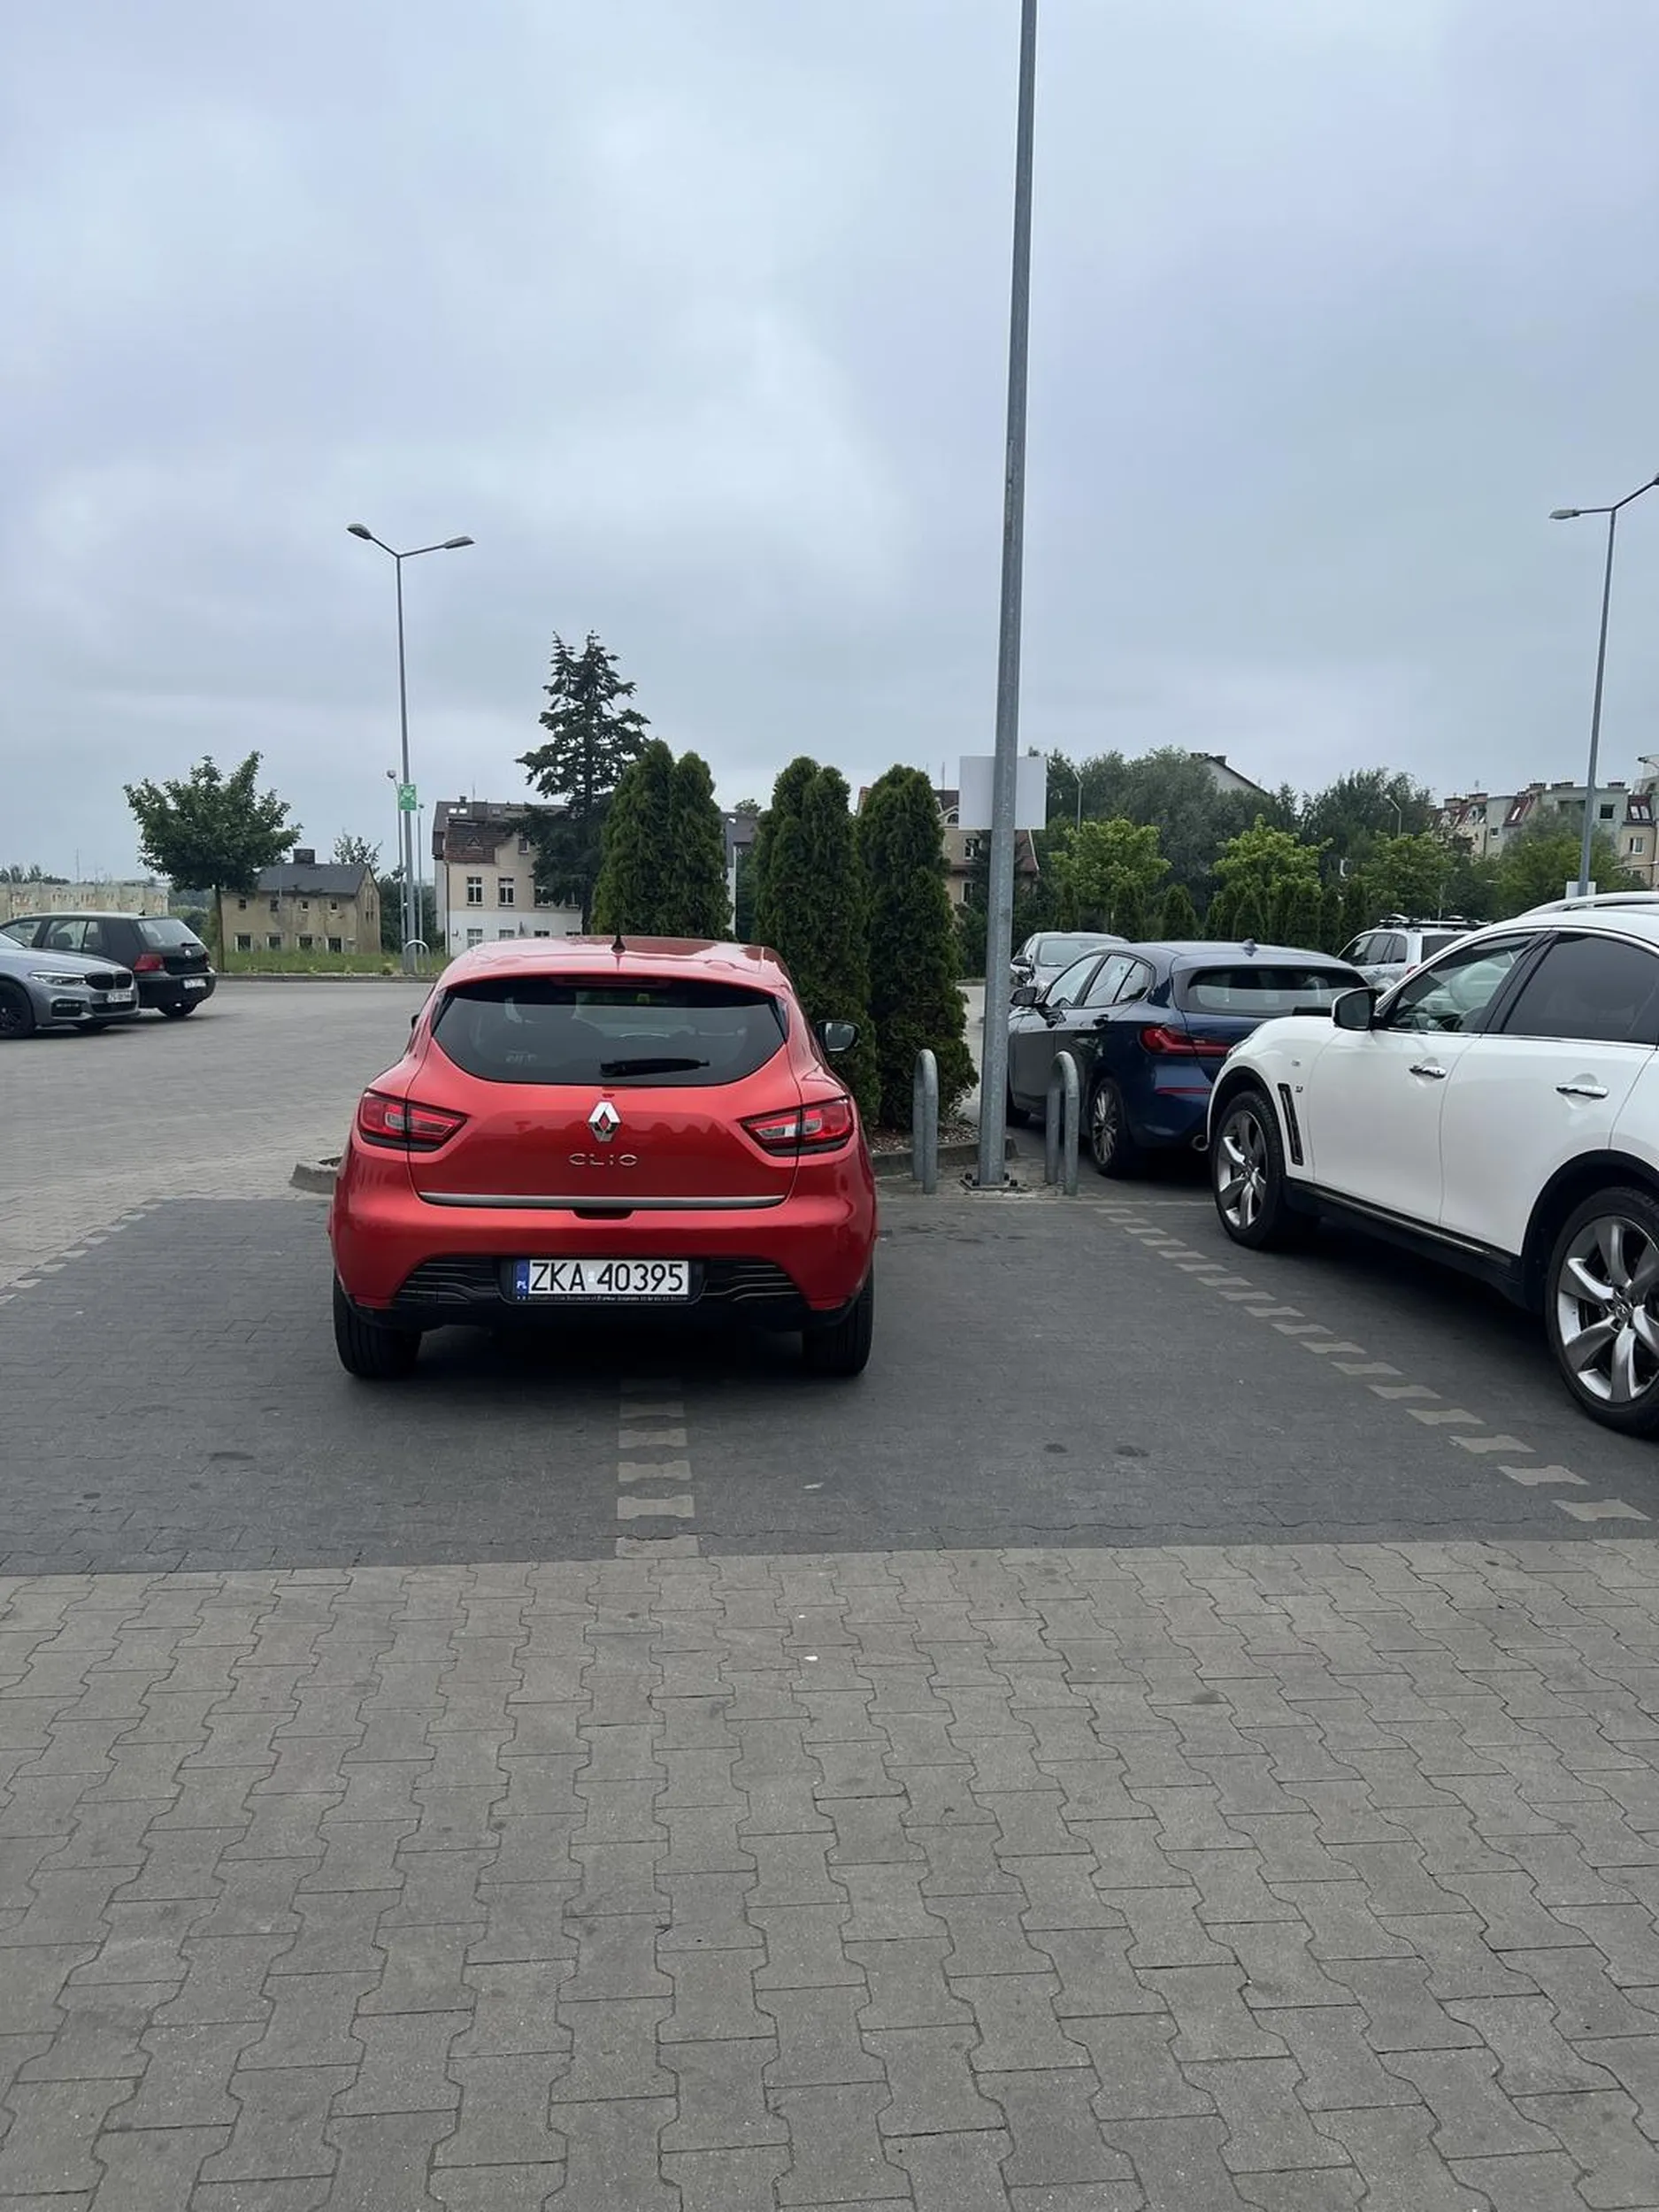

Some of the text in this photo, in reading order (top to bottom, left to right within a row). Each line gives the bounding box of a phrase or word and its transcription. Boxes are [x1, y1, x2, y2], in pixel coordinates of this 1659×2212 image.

[569, 1153, 637, 1166] CLIO
[531, 1263, 682, 1291] ZKA 40395
